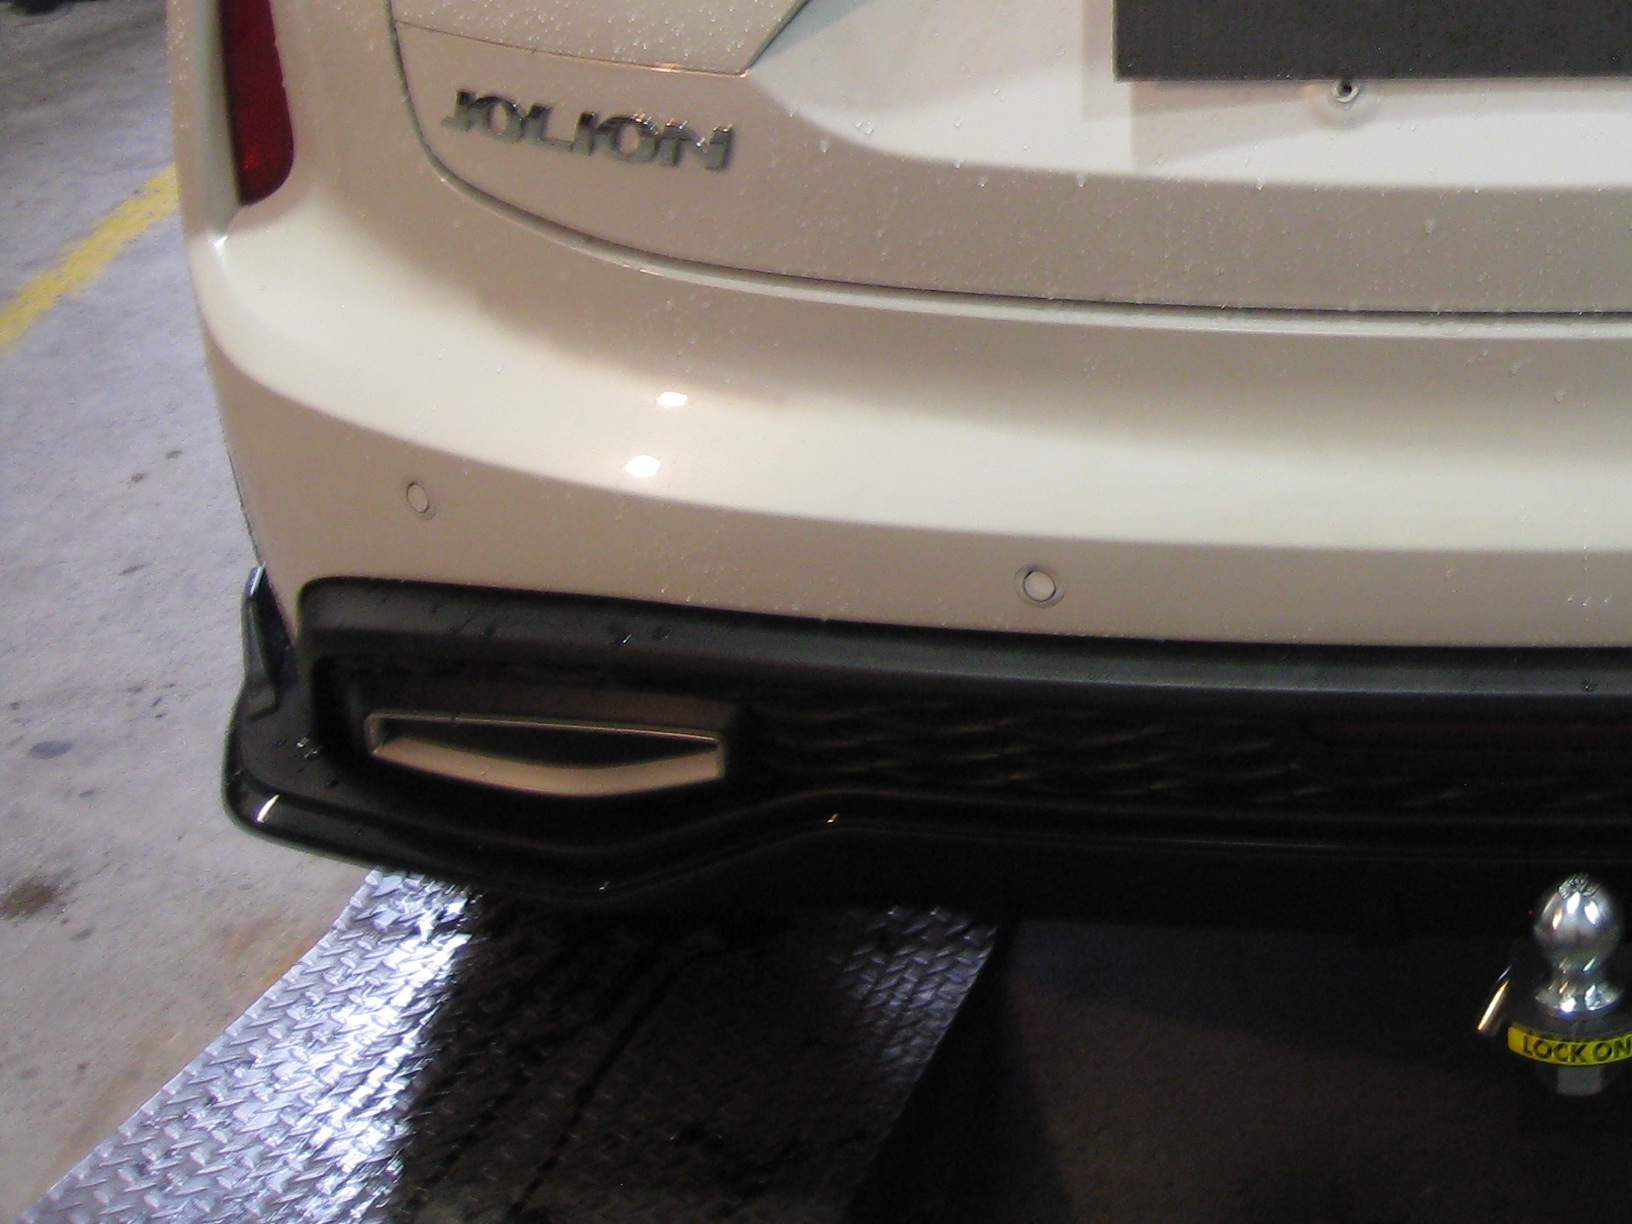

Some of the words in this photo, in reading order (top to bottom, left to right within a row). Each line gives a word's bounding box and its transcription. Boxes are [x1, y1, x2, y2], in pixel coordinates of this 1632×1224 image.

[442, 89, 734, 171] JOLION
[1522, 1035, 1588, 1063] LOCK
[1592, 1038, 1631, 1062] ON
